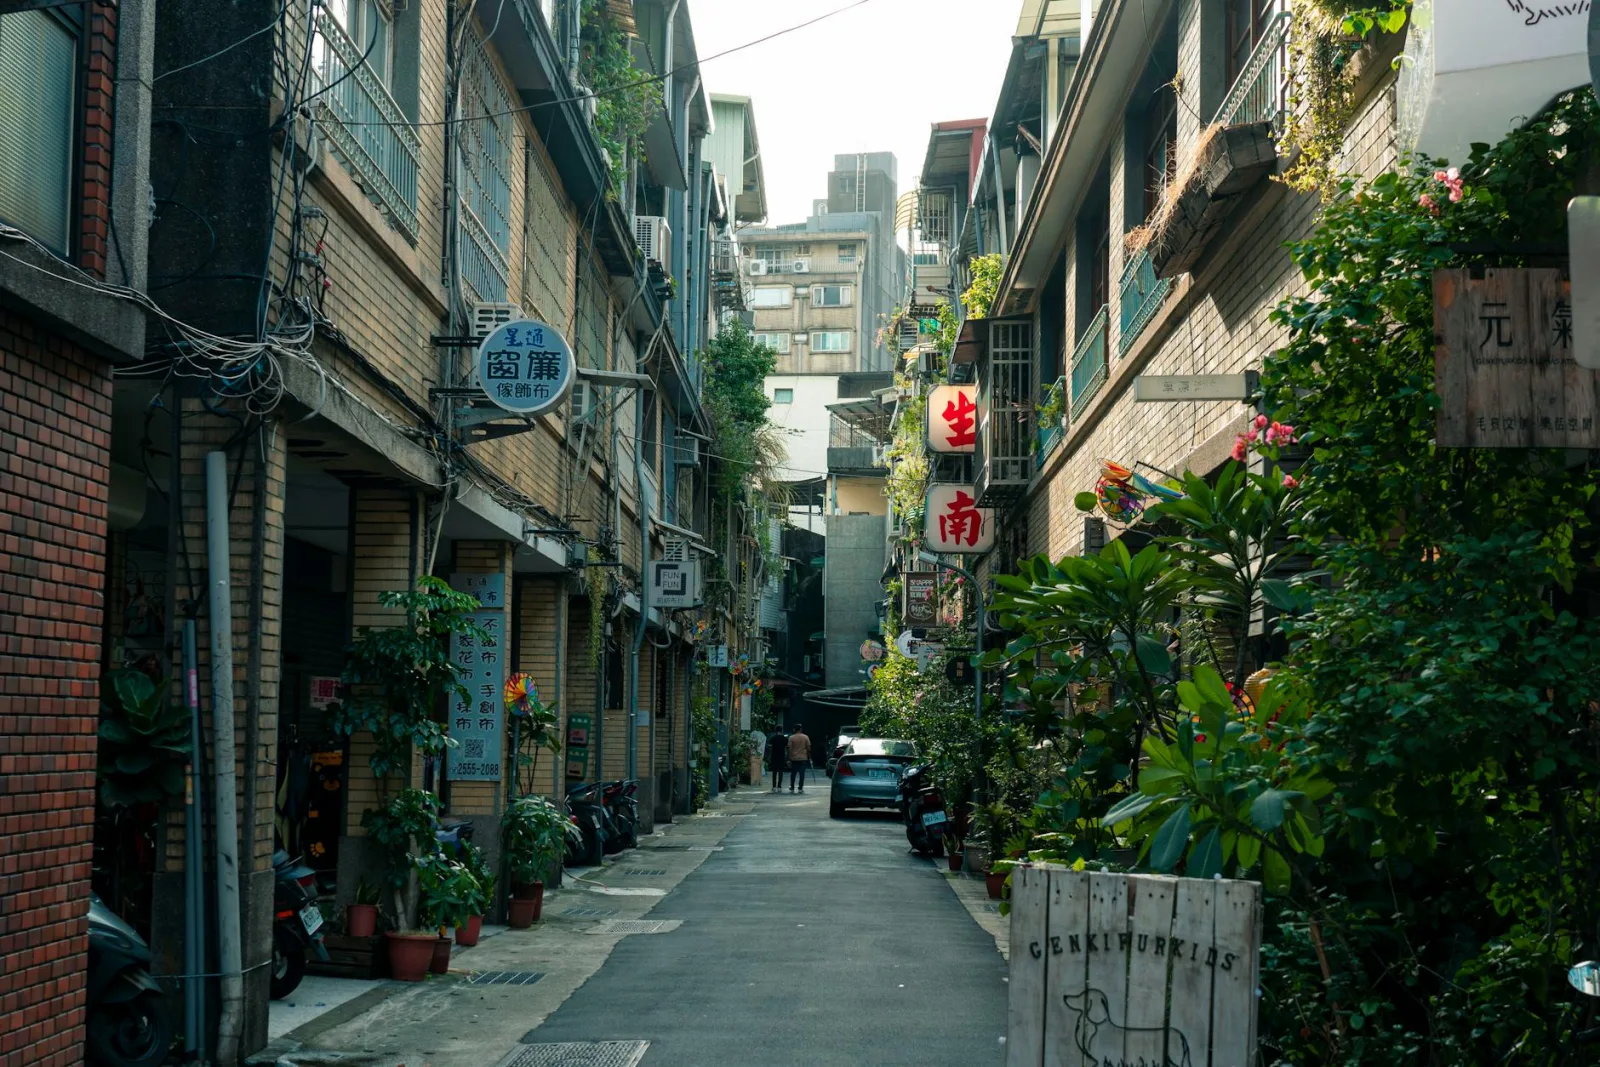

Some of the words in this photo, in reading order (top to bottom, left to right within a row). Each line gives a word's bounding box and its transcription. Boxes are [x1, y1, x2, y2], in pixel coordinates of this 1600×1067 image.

[504, 327, 546, 348] 星通
[486, 349, 562, 381] 窗簾
[496, 382, 550, 399] 傢飾布
[941, 390, 976, 447] 生
[939, 490, 982, 547] 南
[662, 571, 680, 579] FUN
[662, 581, 679, 589] FUN
[457, 763, 499, 776] 2555-2088
[1029, 931, 1237, 972] GENKIFURKIDS
